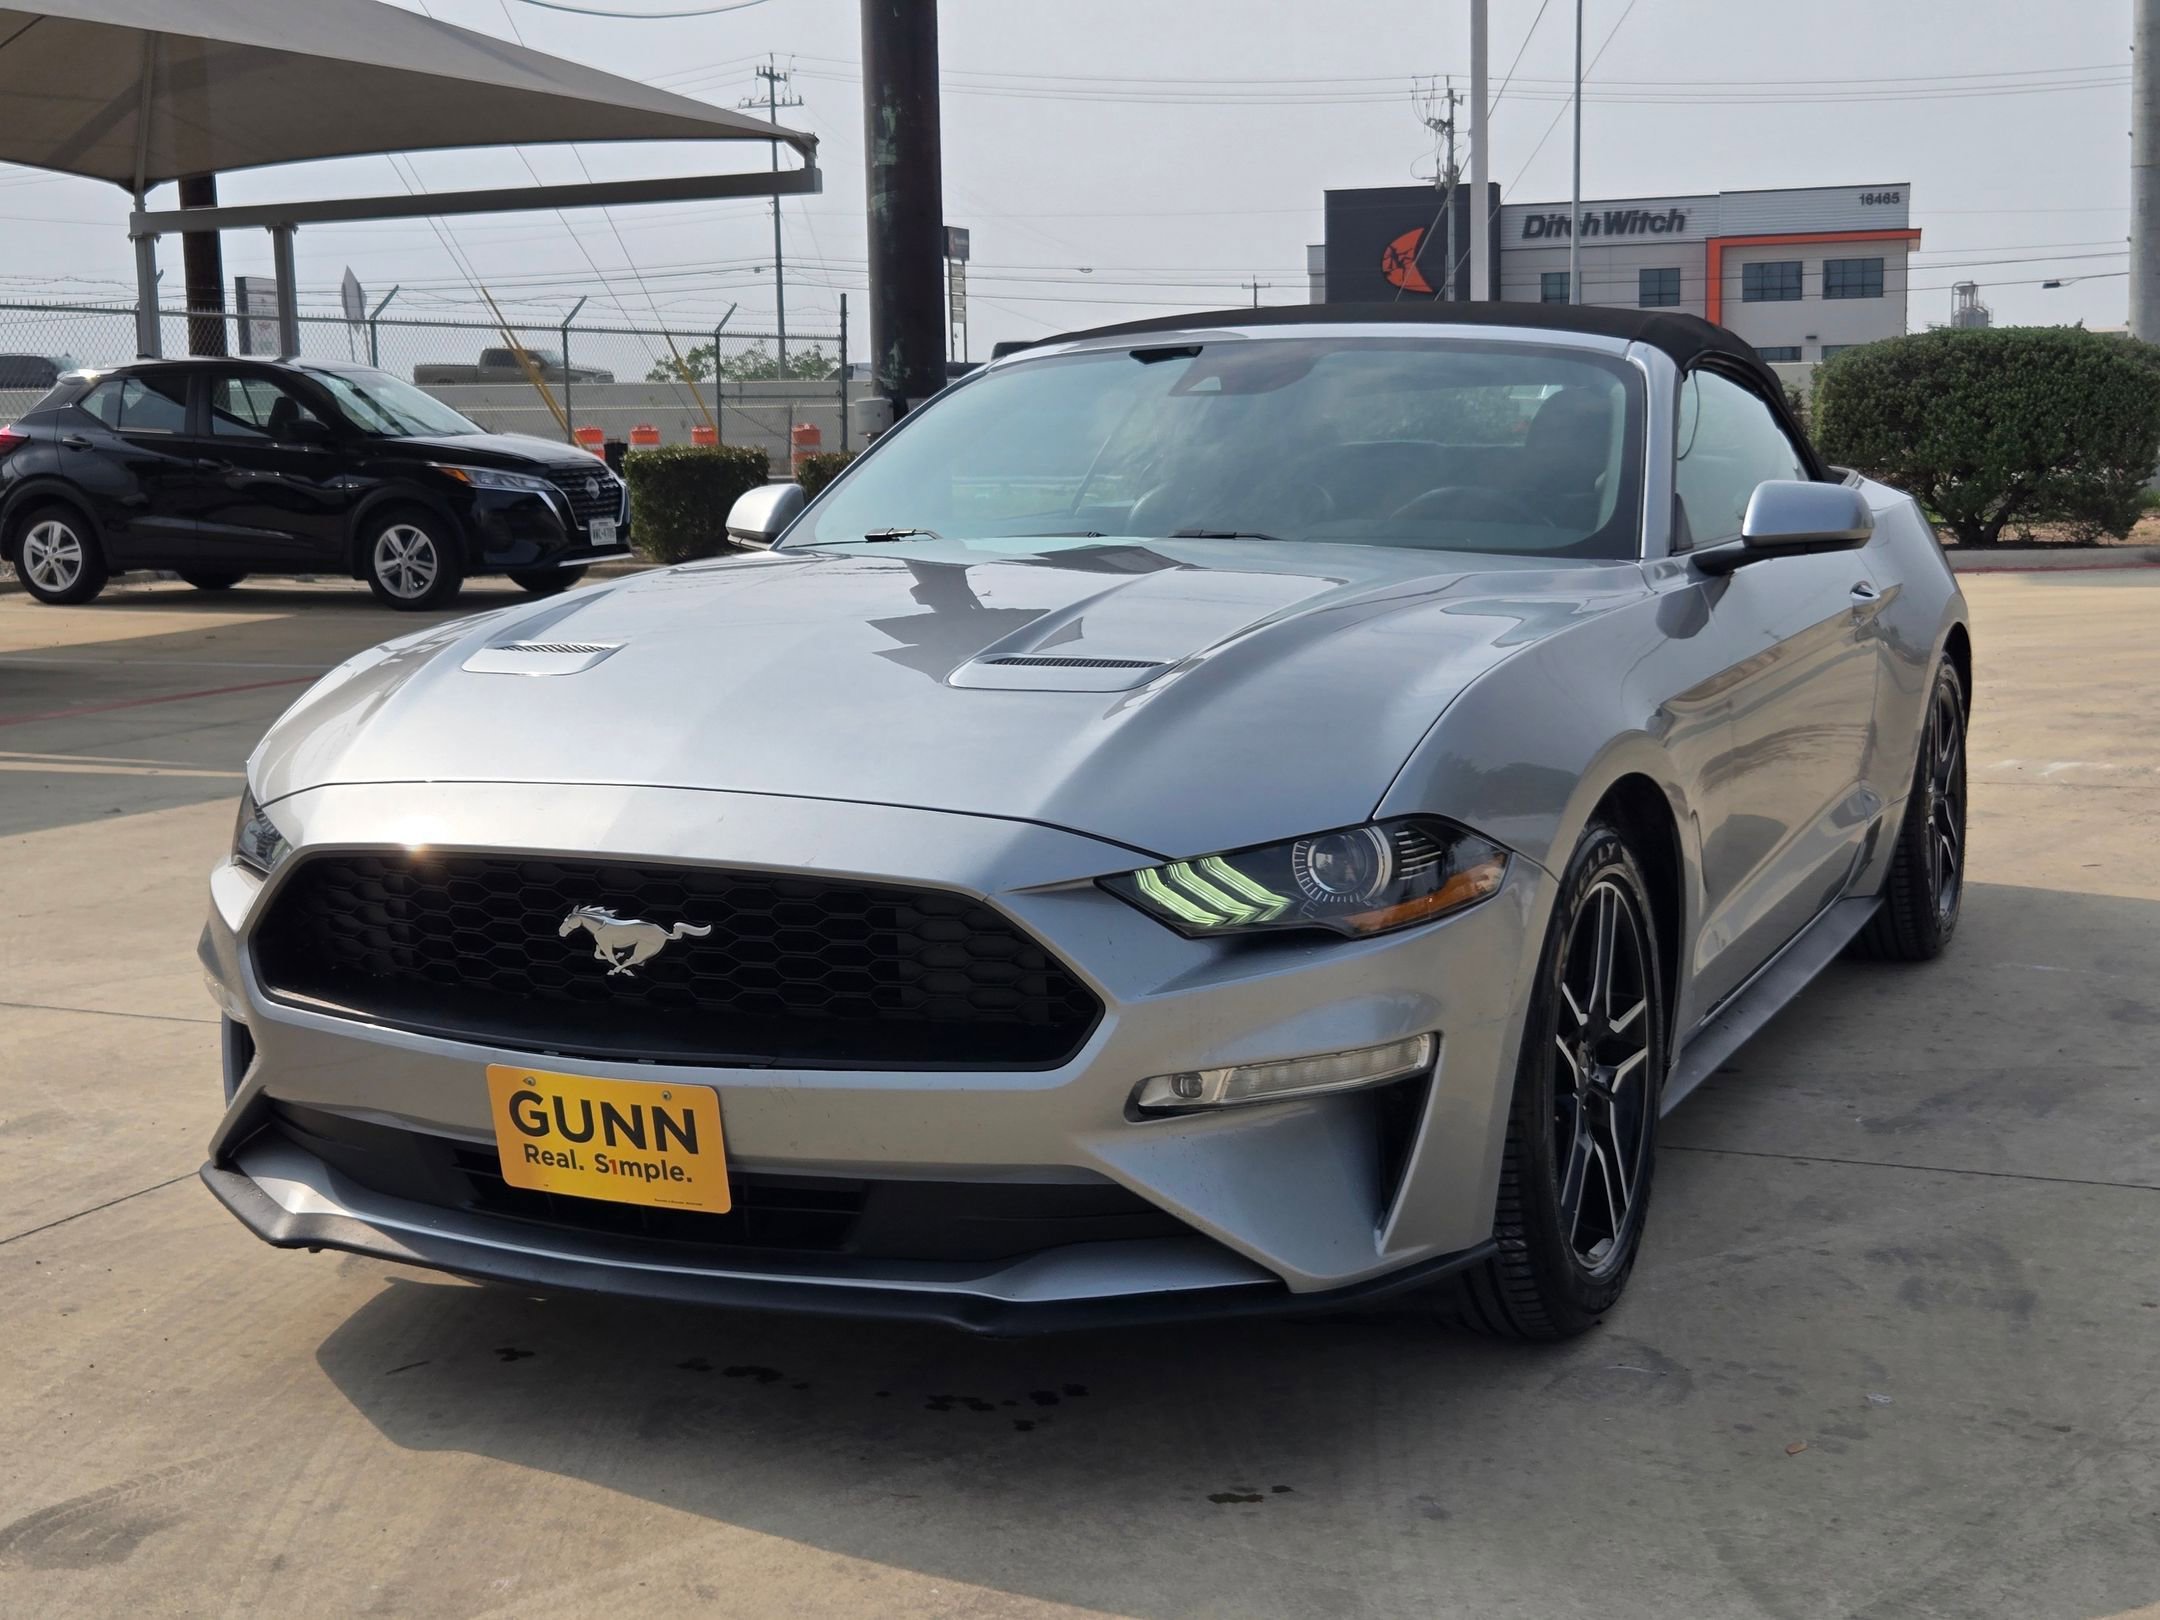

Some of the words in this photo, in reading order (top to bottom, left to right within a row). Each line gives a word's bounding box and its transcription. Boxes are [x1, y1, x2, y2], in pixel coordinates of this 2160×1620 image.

[1859, 191, 1900, 206] 16465
[1521, 212, 1600, 238] Ditch
[1603, 208, 1685, 234] Witch
[508, 1089, 699, 1155] GUNN
[523, 1143, 585, 1171] Real.
